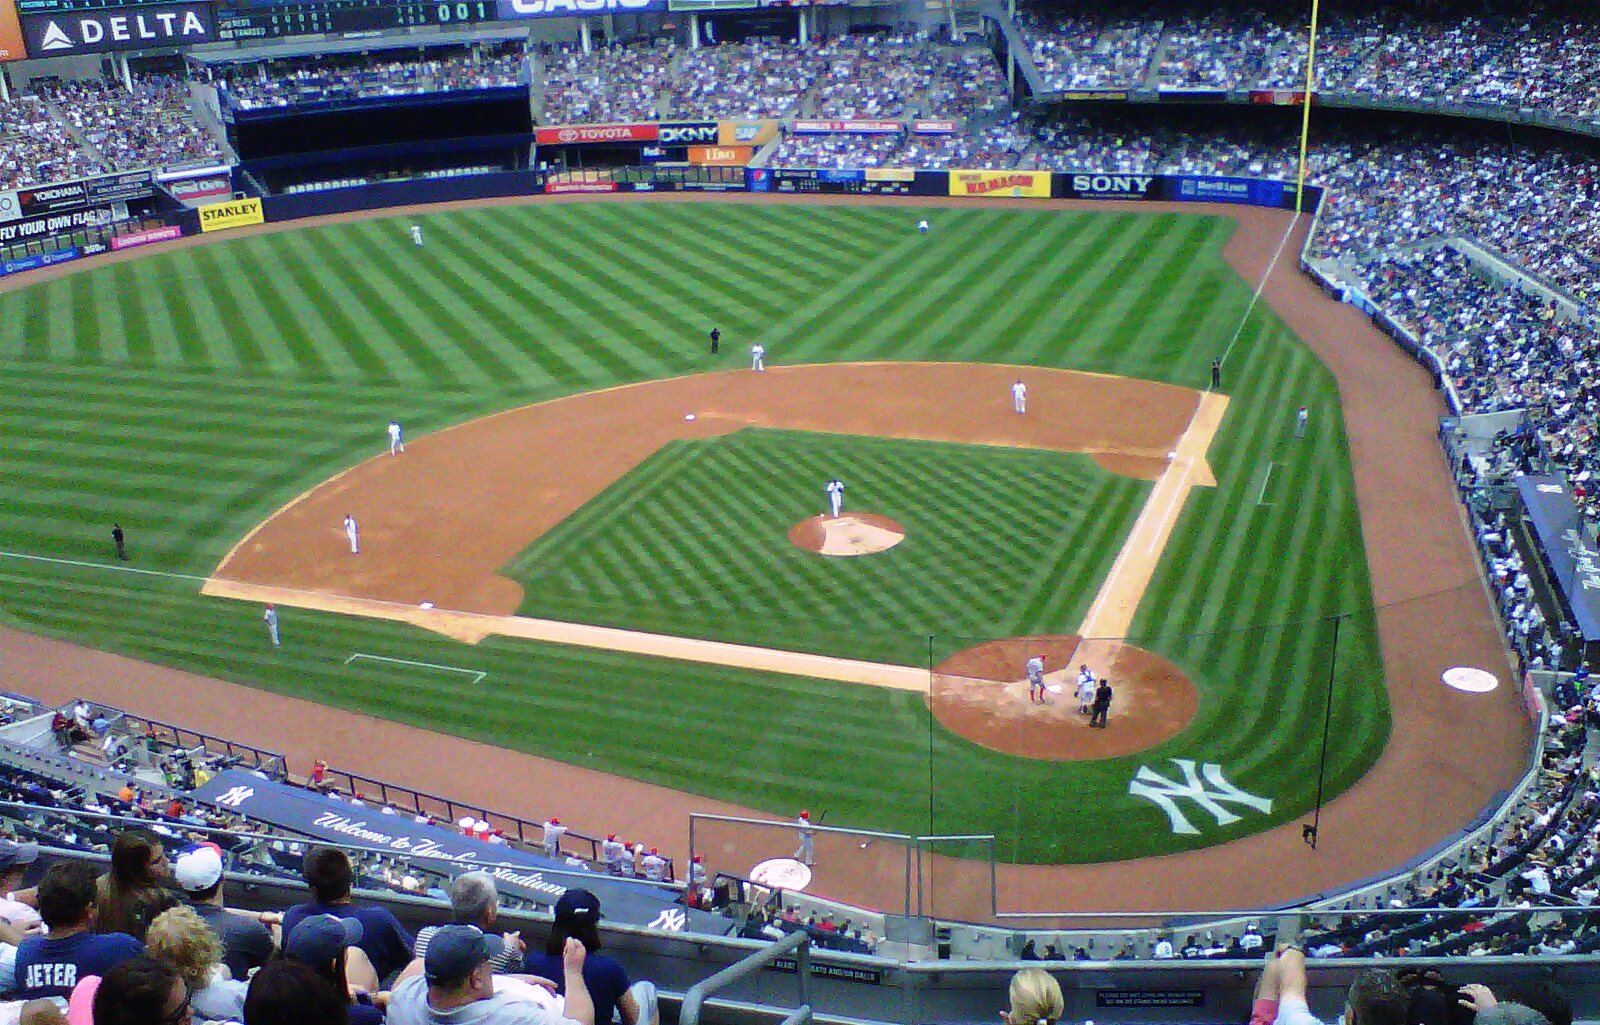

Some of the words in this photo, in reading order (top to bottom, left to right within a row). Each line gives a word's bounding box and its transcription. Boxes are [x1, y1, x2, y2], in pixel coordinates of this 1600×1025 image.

[438, 5, 450, 21] 0
[456, 4, 468, 20] 0
[477, 3, 485, 18] 1
[80, 11, 205, 44] DELTA
[581, 128, 632, 139] TOYOTA
[659, 127, 718, 142] DKNY
[1073, 175, 1153, 193] SONY
[33, 186, 84, 202] YOKOHAMA
[203, 203, 257, 221] STANLEY
[0, 224, 17, 240] FLY
[19, 220, 46, 236] YOUR
[48, 214, 72, 231] OWN
[72, 210, 96, 226] FLAG
[312, 811, 392, 843] Welcome
[390, 836, 412, 849] to
[410, 838, 479, 871] Yankee
[482, 861, 568, 896] Stadium
[25, 963, 77, 988] JETER
